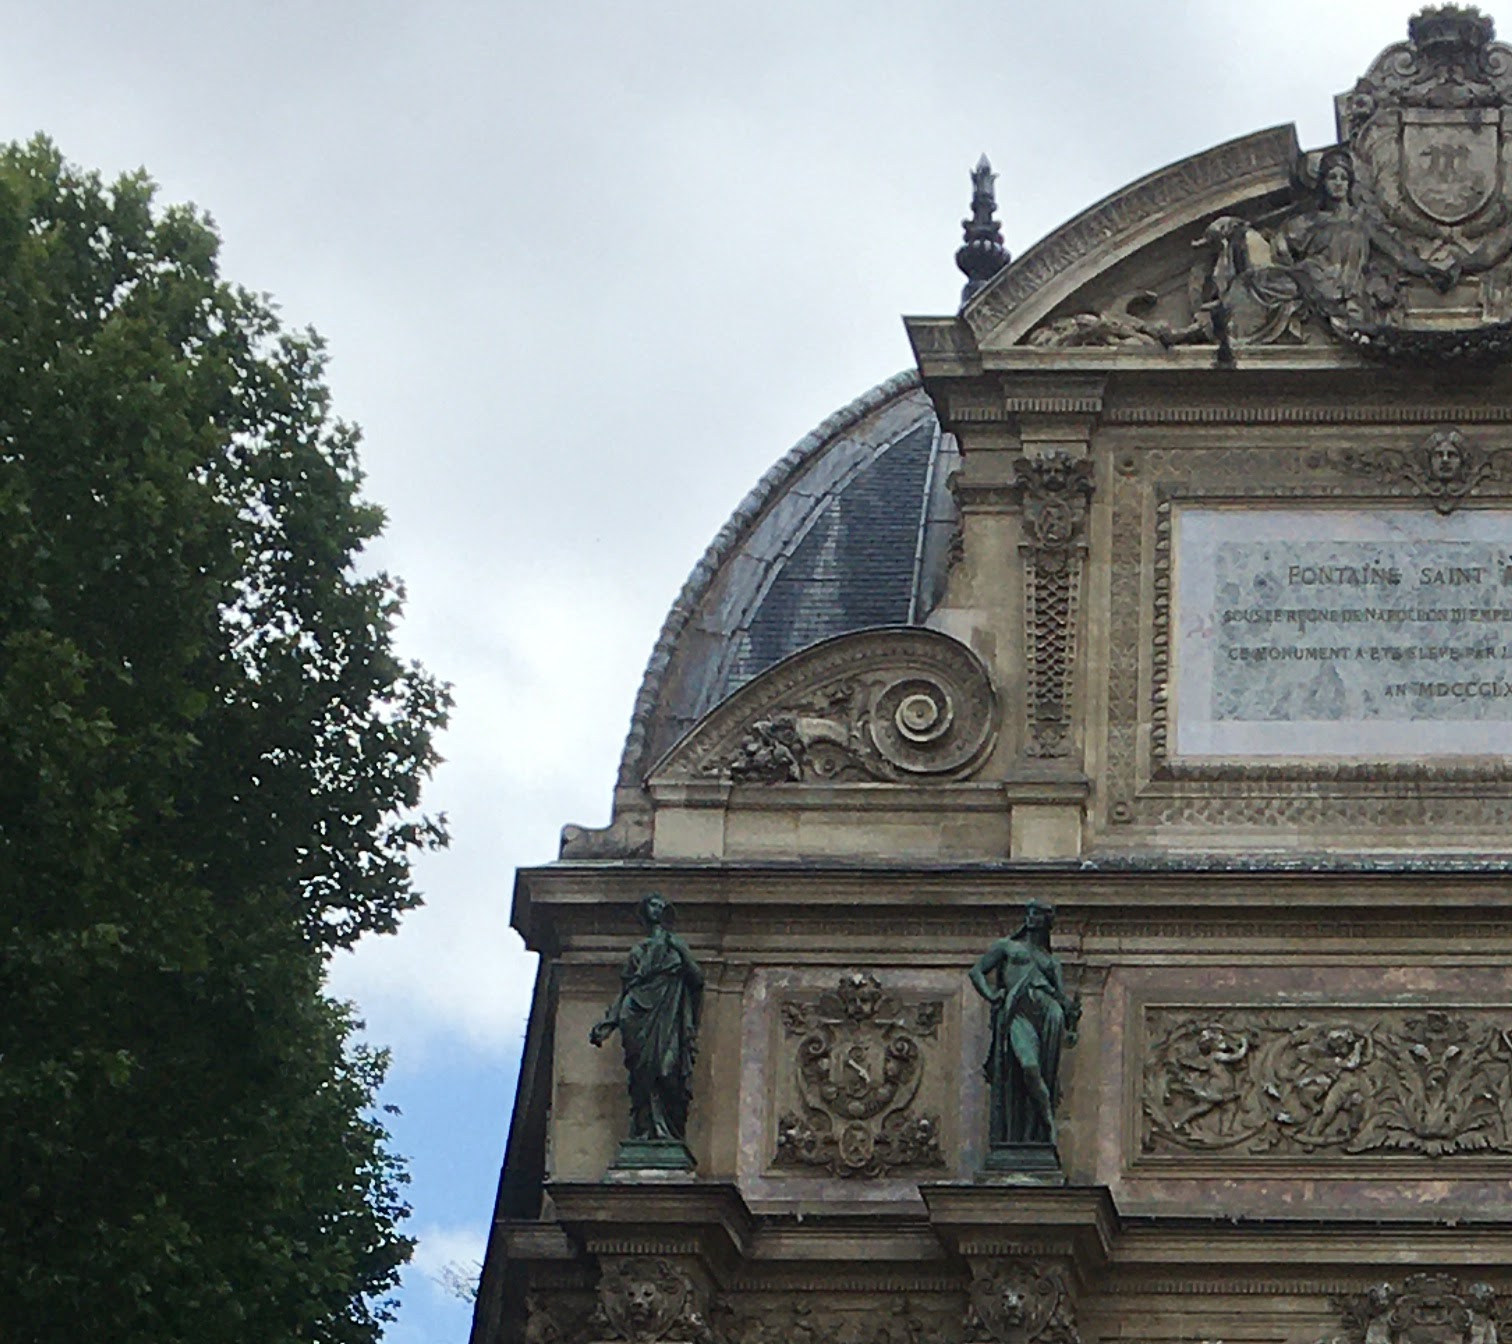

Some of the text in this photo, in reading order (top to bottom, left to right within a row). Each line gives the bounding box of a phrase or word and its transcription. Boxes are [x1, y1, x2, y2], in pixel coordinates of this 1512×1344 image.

[1287, 564, 1403, 586] FONTAINE
[1418, 565, 1486, 586] SAINT
[1223, 608, 1263, 623] SOUS
[1264, 608, 1283, 623] LE
[1341, 608, 1362, 623] DE
[1227, 646, 1250, 661] CE
[1252, 645, 1352, 661] MONUMENT
[1355, 646, 1366, 661] A
[1464, 645, 1496, 660] PAR
[1383, 682, 1407, 697] AN
